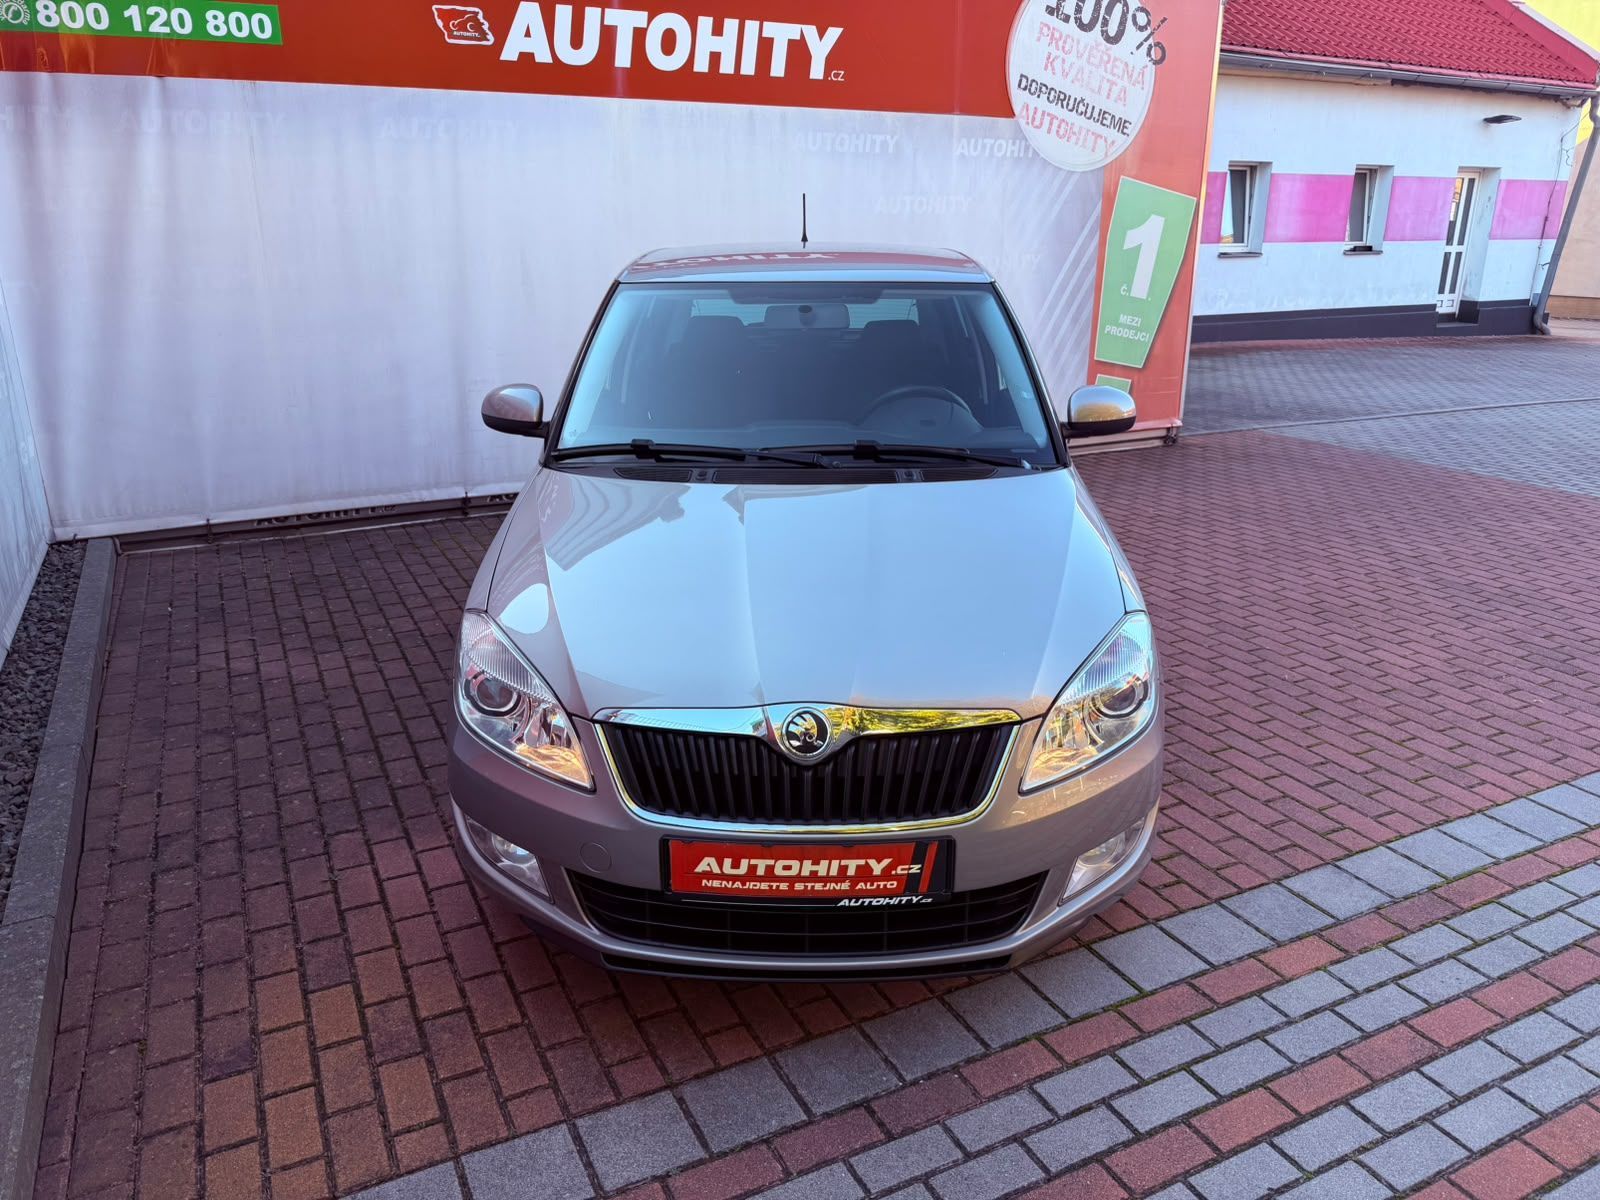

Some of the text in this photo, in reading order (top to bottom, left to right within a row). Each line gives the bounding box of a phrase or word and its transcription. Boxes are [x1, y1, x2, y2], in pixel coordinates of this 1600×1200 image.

[36, 0, 110, 31] 800
[123, 5, 193, 36] 120
[205, 10, 273, 40] 800
[1036, 21, 1149, 91] PROVĚŘENÁ
[1044, 51, 1128, 107] KVALITA
[1017, 74, 1133, 137] DOPORUČUJEME
[791, 131, 898, 155] AUTOHITY
[1018, 102, 1117, 159] AUTOHITY
[954, 137, 1040, 159] AUTOHIT
[1104, 324, 1150, 343] PRODEJCI
[1119, 313, 1142, 328] MEZI
[702, 879, 898, 891] NENAJDETE STEJNÉ AUTO
